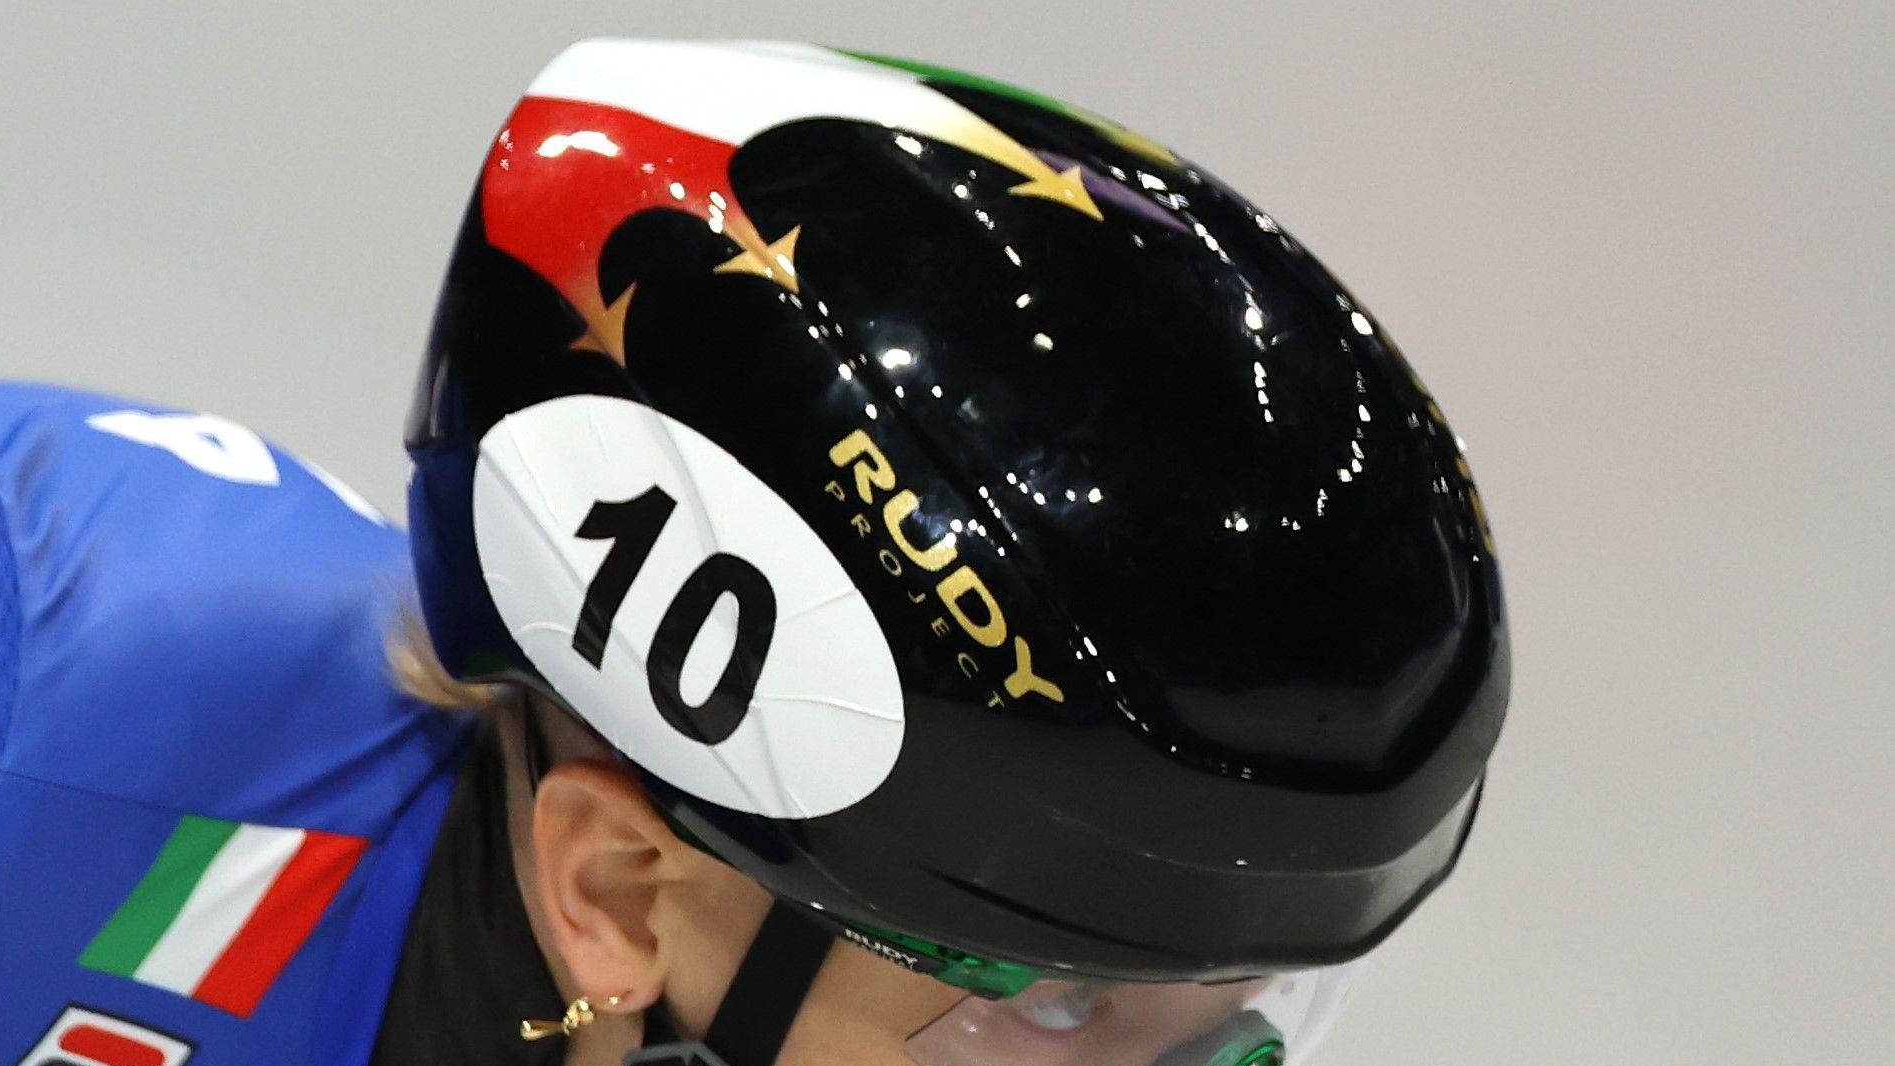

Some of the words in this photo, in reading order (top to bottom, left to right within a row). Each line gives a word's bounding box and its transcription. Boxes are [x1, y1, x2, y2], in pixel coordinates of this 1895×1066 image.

[572, 484, 777, 745] 10
[824, 480, 1005, 709] PROJECT
[829, 430, 1064, 702] RUDY
[844, 927, 918, 969] RUDY
